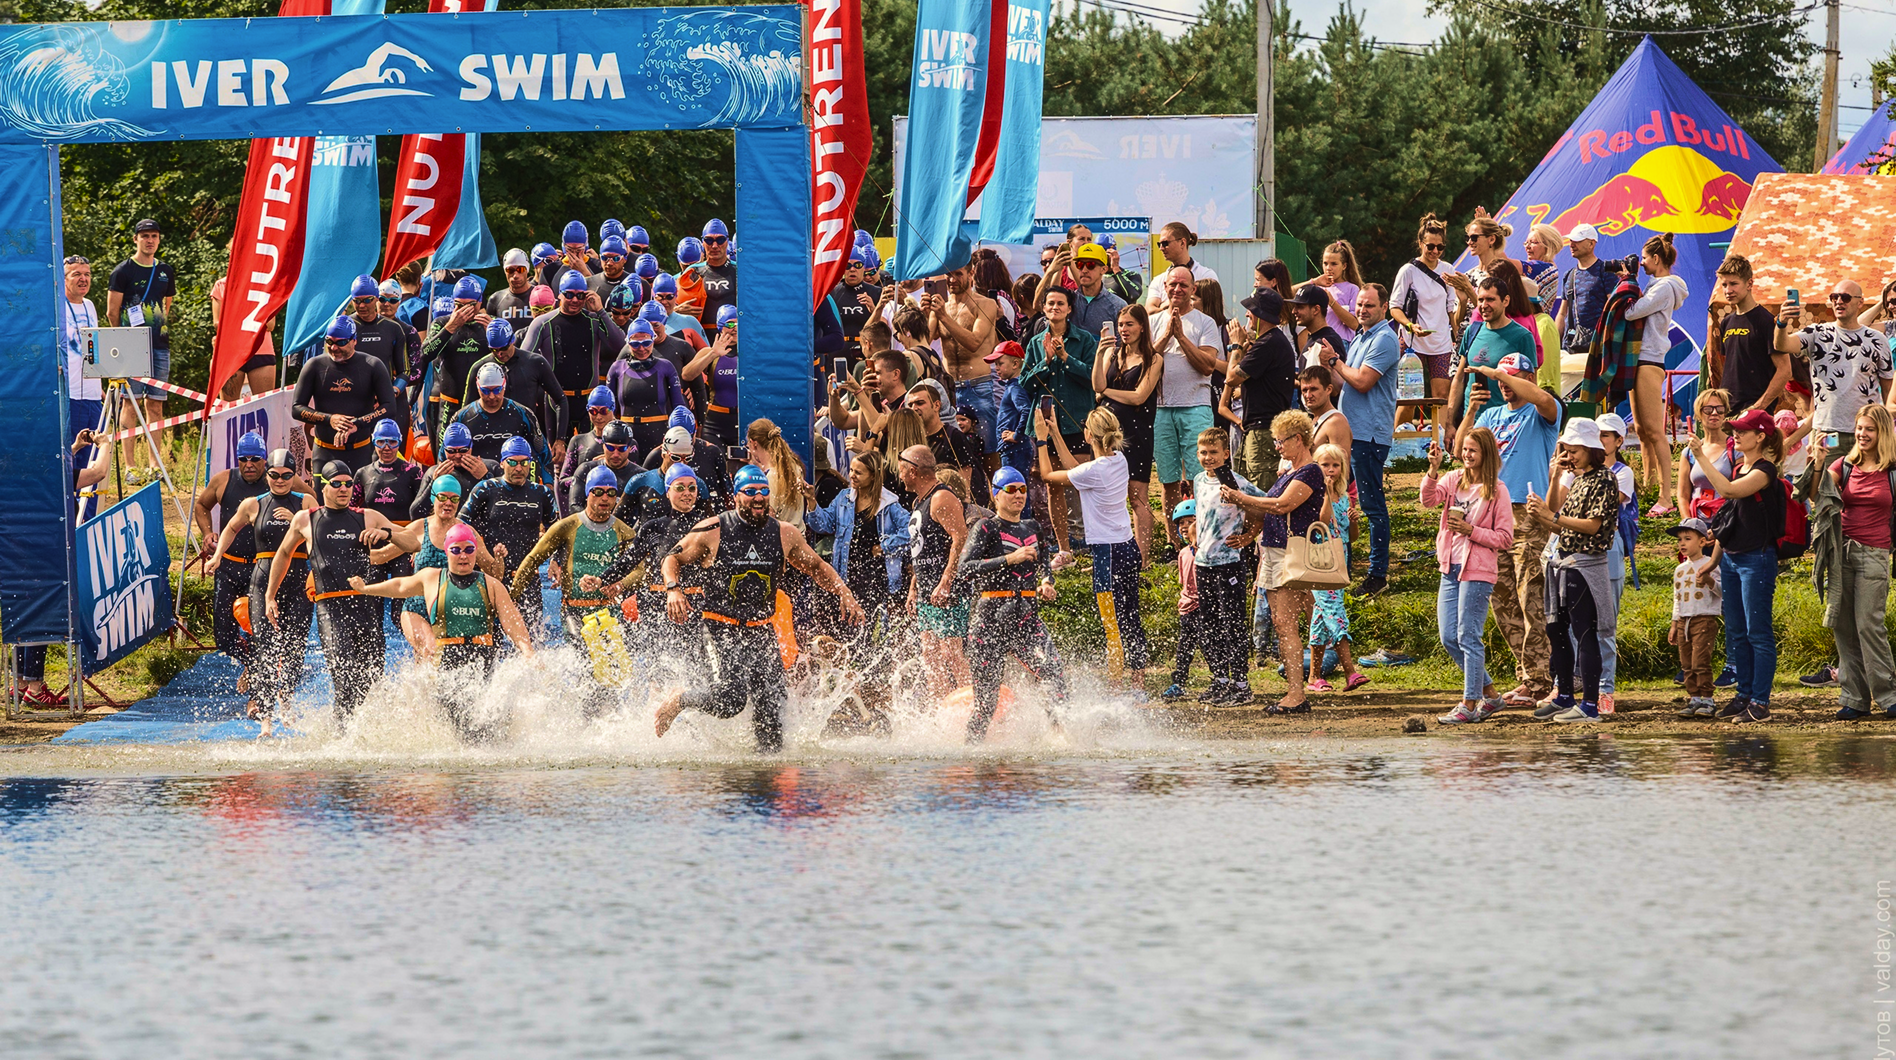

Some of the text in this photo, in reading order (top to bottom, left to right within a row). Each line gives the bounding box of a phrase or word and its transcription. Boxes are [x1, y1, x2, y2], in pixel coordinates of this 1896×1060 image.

[921, 29, 978, 63] IVER
[151, 52, 626, 109] IVER SWIM
[918, 61, 975, 91] SWIM
[1579, 110, 1667, 165] Red
[1670, 111, 1750, 160] Bull
[1103, 219, 1138, 230] 5000
[705, 280, 730, 290] TYR
[502, 306, 533, 319] dhb
[842, 306, 864, 314] TYR
[87, 501, 151, 600] IVER
[93, 579, 155, 661] SWIM
